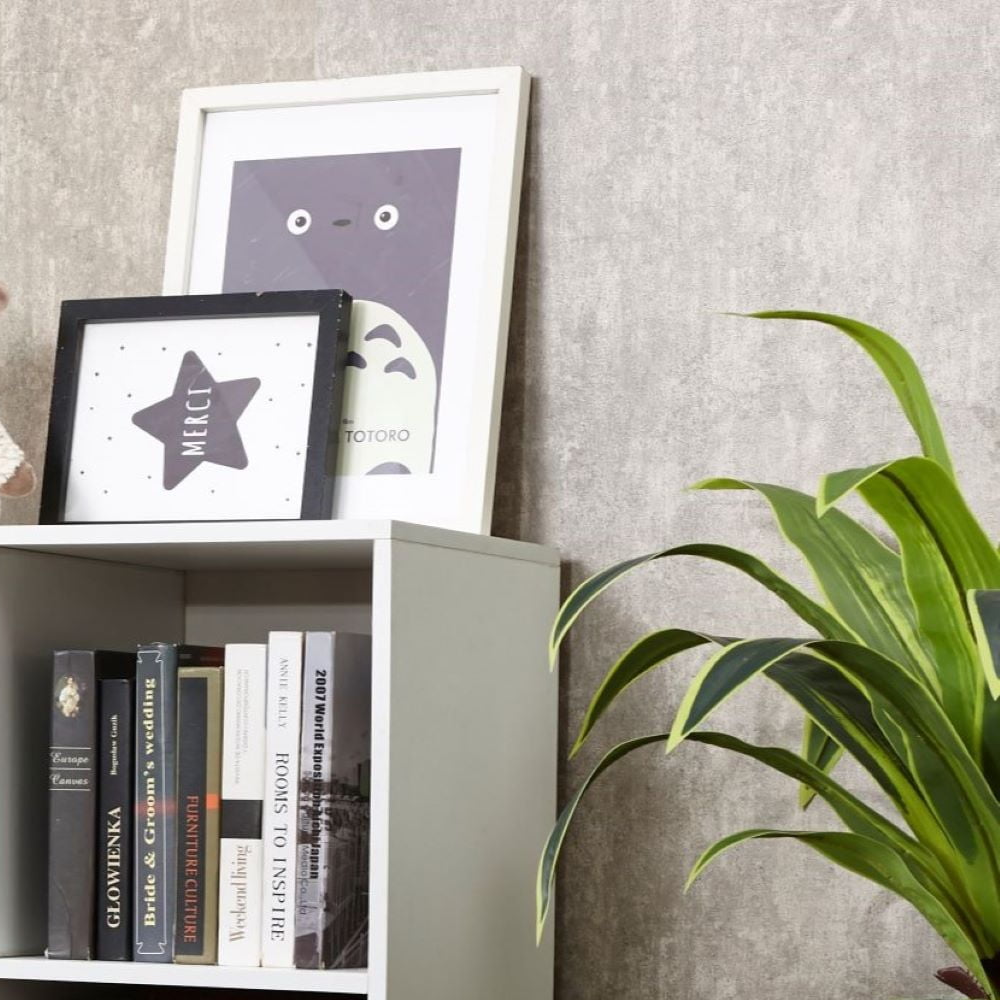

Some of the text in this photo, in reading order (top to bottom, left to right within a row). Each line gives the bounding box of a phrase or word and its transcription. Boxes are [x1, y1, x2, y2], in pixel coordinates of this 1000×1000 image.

[180, 386, 212, 457] MERCI
[345, 429, 410, 443] TOTORO
[278, 657, 290, 729] ANNIE KELLY
[315, 669, 326, 701] 2007
[314, 703, 326, 740] World
[50, 752, 89, 767] Europe
[143, 678, 157, 927] Bride & Groom's wedding
[183, 795, 200, 944] FURNITURE CULTURE
[270, 752, 290, 942] ROOMS TO INSPIRE
[310, 843, 321, 879] Japan
[229, 844, 251, 943] Weekend living
